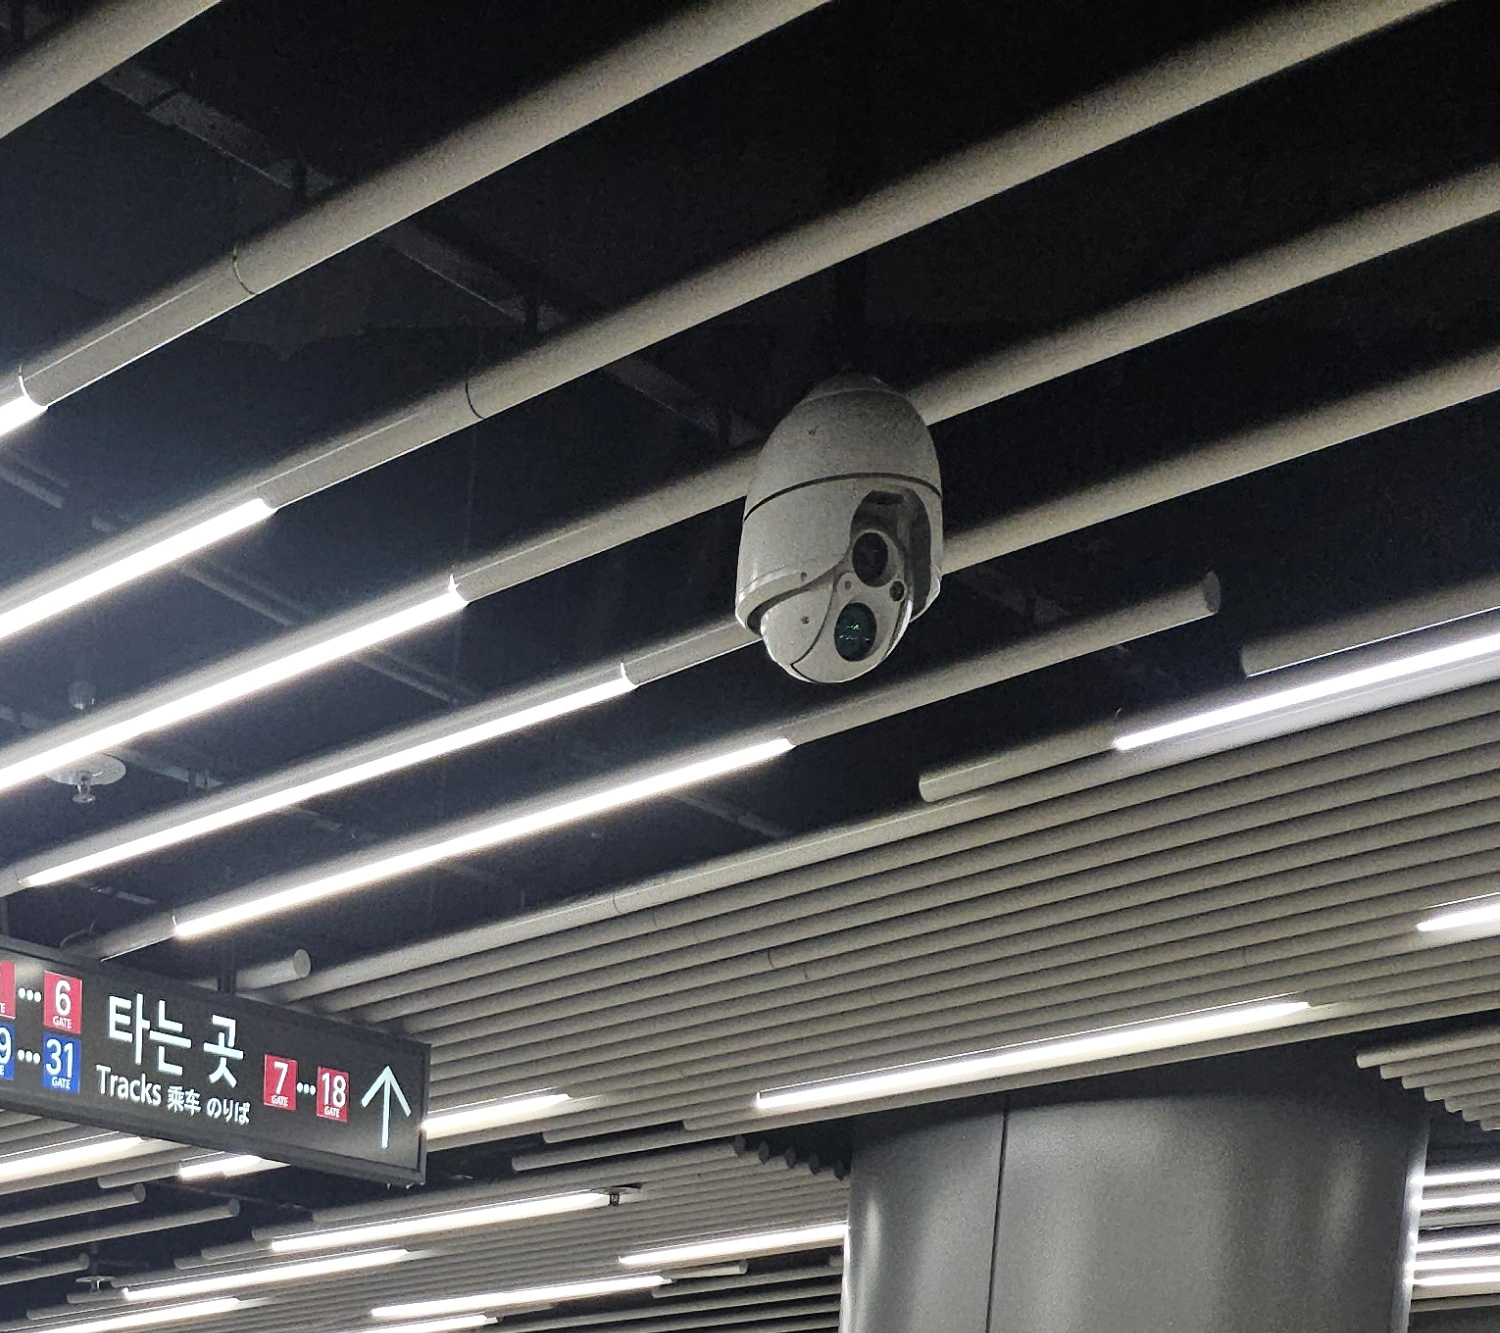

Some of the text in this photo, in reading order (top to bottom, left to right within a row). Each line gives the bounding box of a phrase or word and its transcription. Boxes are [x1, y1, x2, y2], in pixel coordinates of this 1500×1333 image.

[55, 980, 71, 1016] 6
[52, 1016, 72, 1029] GATE
[108, 993, 244, 1088] 타는 곳
[46, 1039, 73, 1079] 31
[51, 1077, 71, 1090] GATE
[96, 1064, 162, 1107] Tracks
[206, 1097, 250, 1125] のりば
[274, 1062, 347, 1108] 7 18
[270, 1095, 341, 1119] GATE GATE
